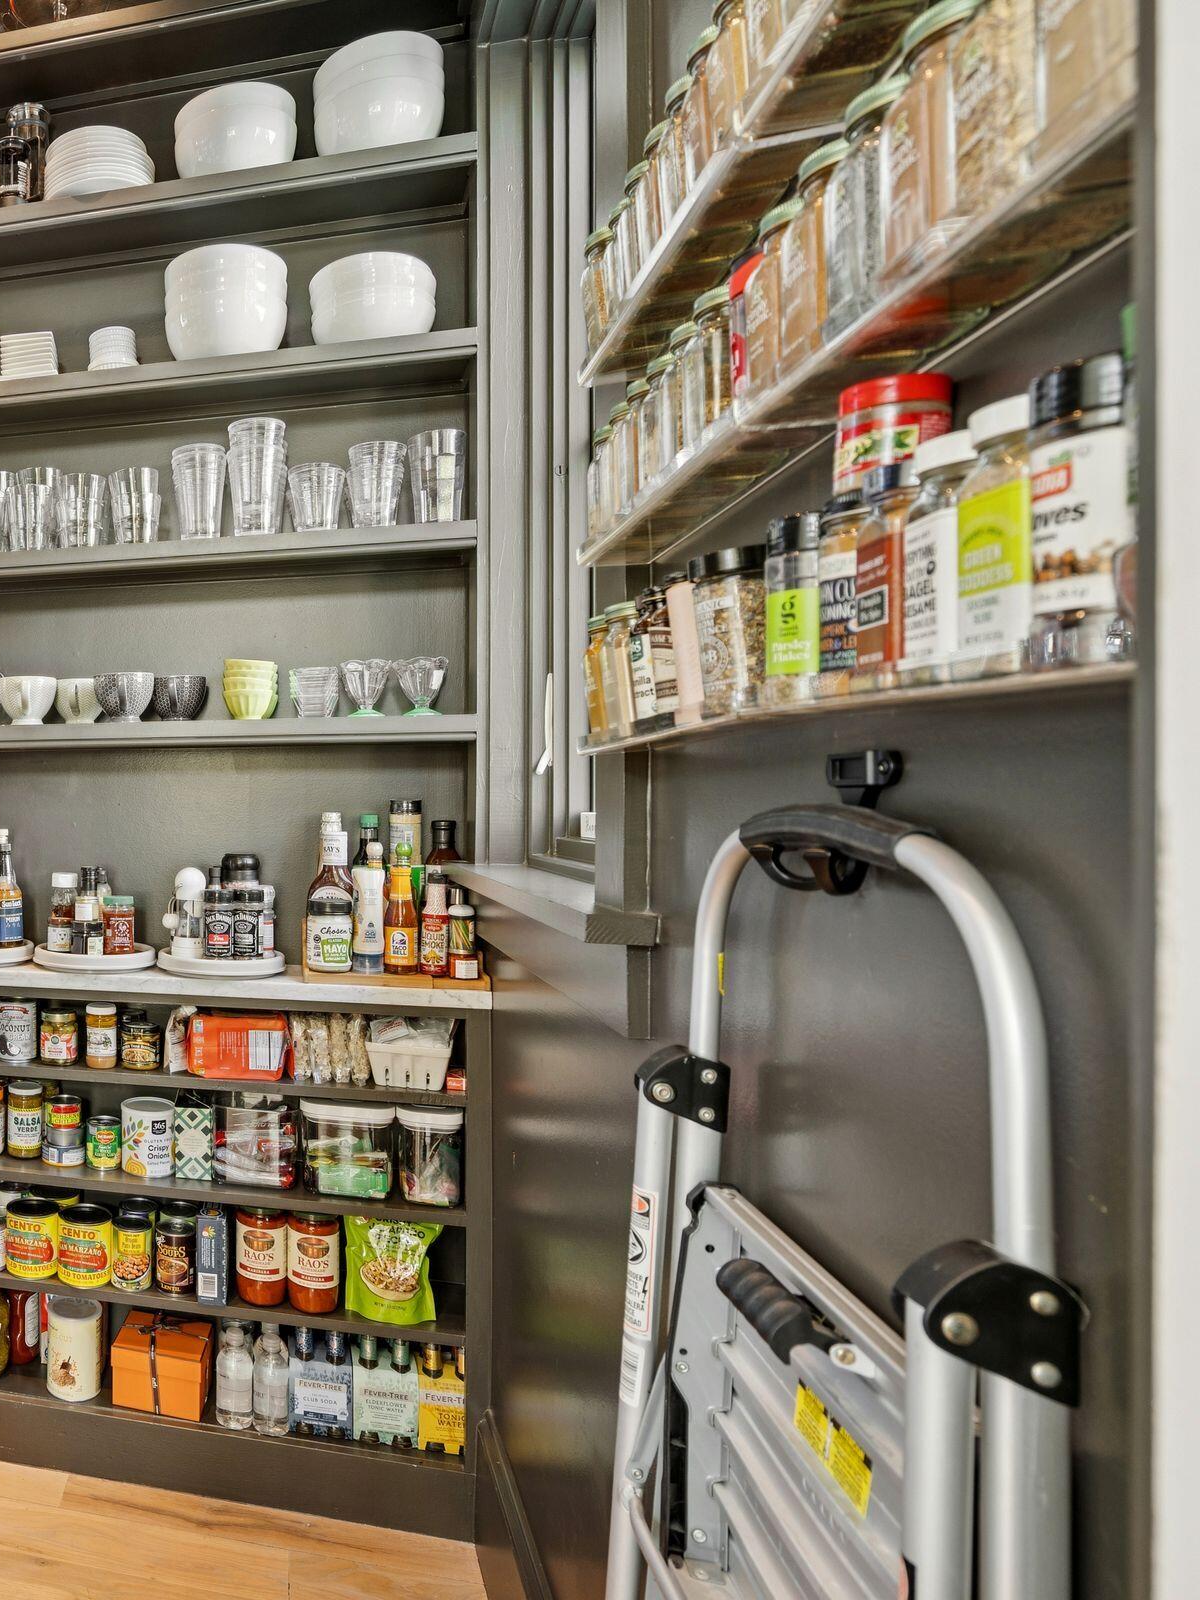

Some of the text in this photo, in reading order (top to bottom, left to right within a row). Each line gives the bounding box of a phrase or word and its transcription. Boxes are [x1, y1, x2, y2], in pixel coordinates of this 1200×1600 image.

[906, 576, 937, 601] AGEL
[906, 597, 937, 619] ESAME
[320, 926, 349, 935] Chosen
[423, 932, 446, 941] LIQUID
[323, 944, 348, 954] MAYO
[392, 944, 408, 952] TACO
[13, 1116, 41, 1127] SALSA
[152, 1121, 166, 1130] 365
[16, 1126, 39, 1134] VERDE
[147, 1144, 170, 1152] Crispy
[147, 1152, 170, 1160] Onions
[9, 1219, 41, 1233] CENTO
[62, 1226, 97, 1240] CENTO
[14, 1237, 48, 1249] MARZANO
[68, 1243, 103, 1257] MARZANO
[158, 1245, 187, 1259] SOUPS
[244, 1249, 275, 1263] RAO'S
[298, 1256, 330, 1270] RAO'S
[160, 1282, 182, 1292] LENTIL
[298, 1379, 343, 1393] FEVER-TREE
[363, 1388, 409, 1402] FEVER-TREE
[425, 1393, 466, 1406] FEVER-T
[320, 1398, 338, 1406] SODA
[368, 1404, 404, 1415] TONIC WATER
[437, 1420, 466, 1431] WATE
